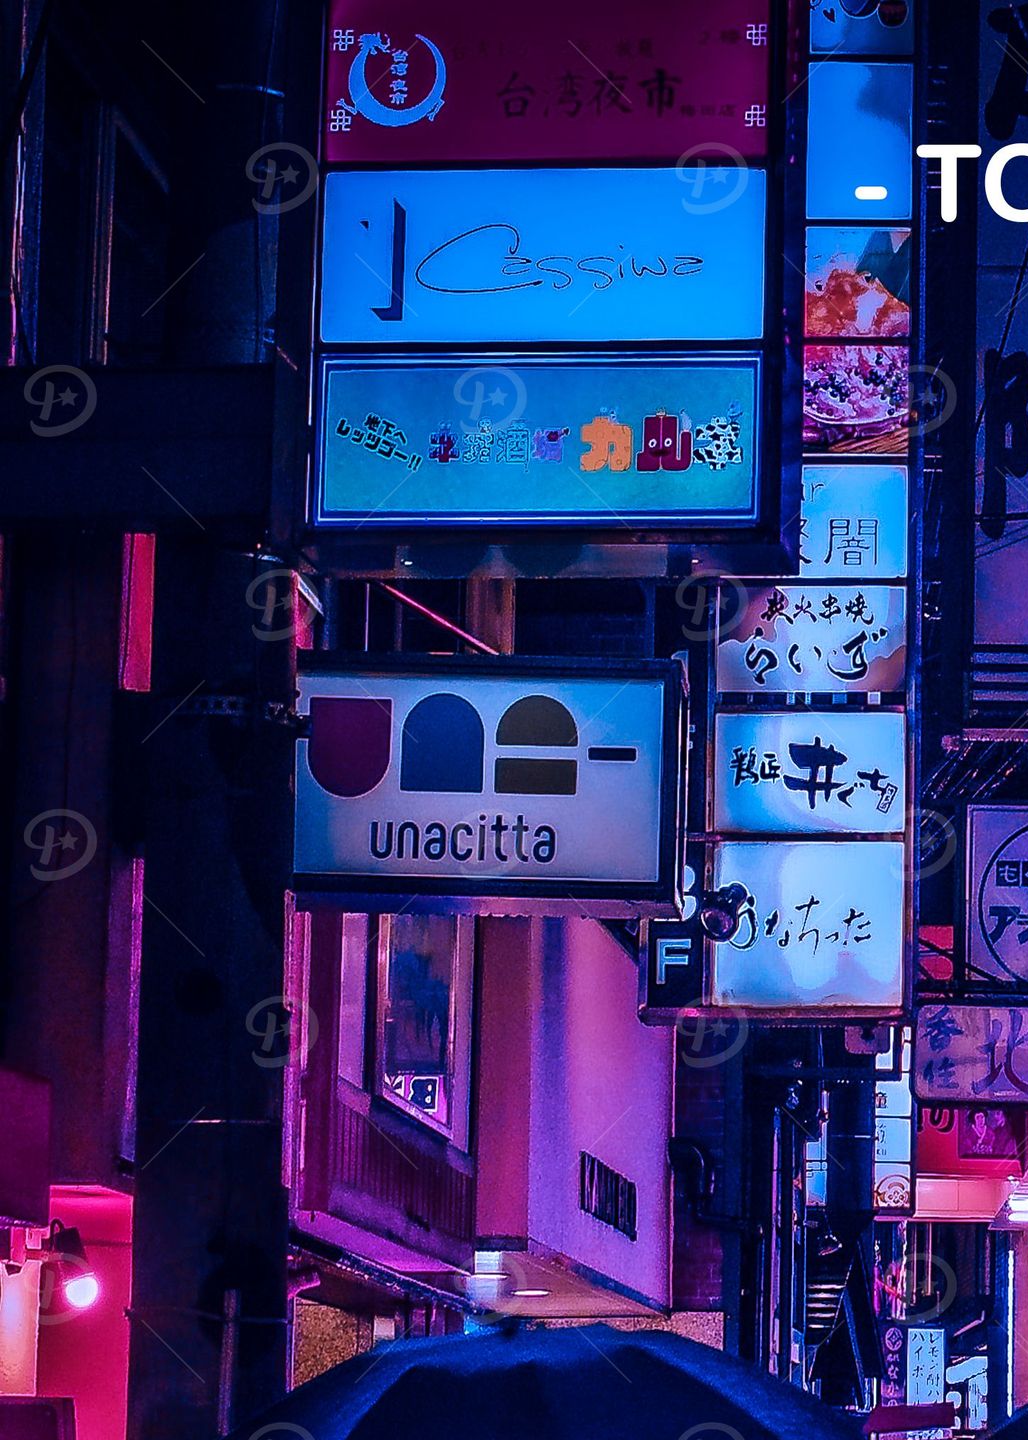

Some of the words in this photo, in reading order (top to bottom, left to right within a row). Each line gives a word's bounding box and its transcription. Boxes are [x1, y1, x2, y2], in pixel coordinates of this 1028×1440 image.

[496, 68, 682, 119] 台湾夜市
[369, 815, 557, 864] unacitta
